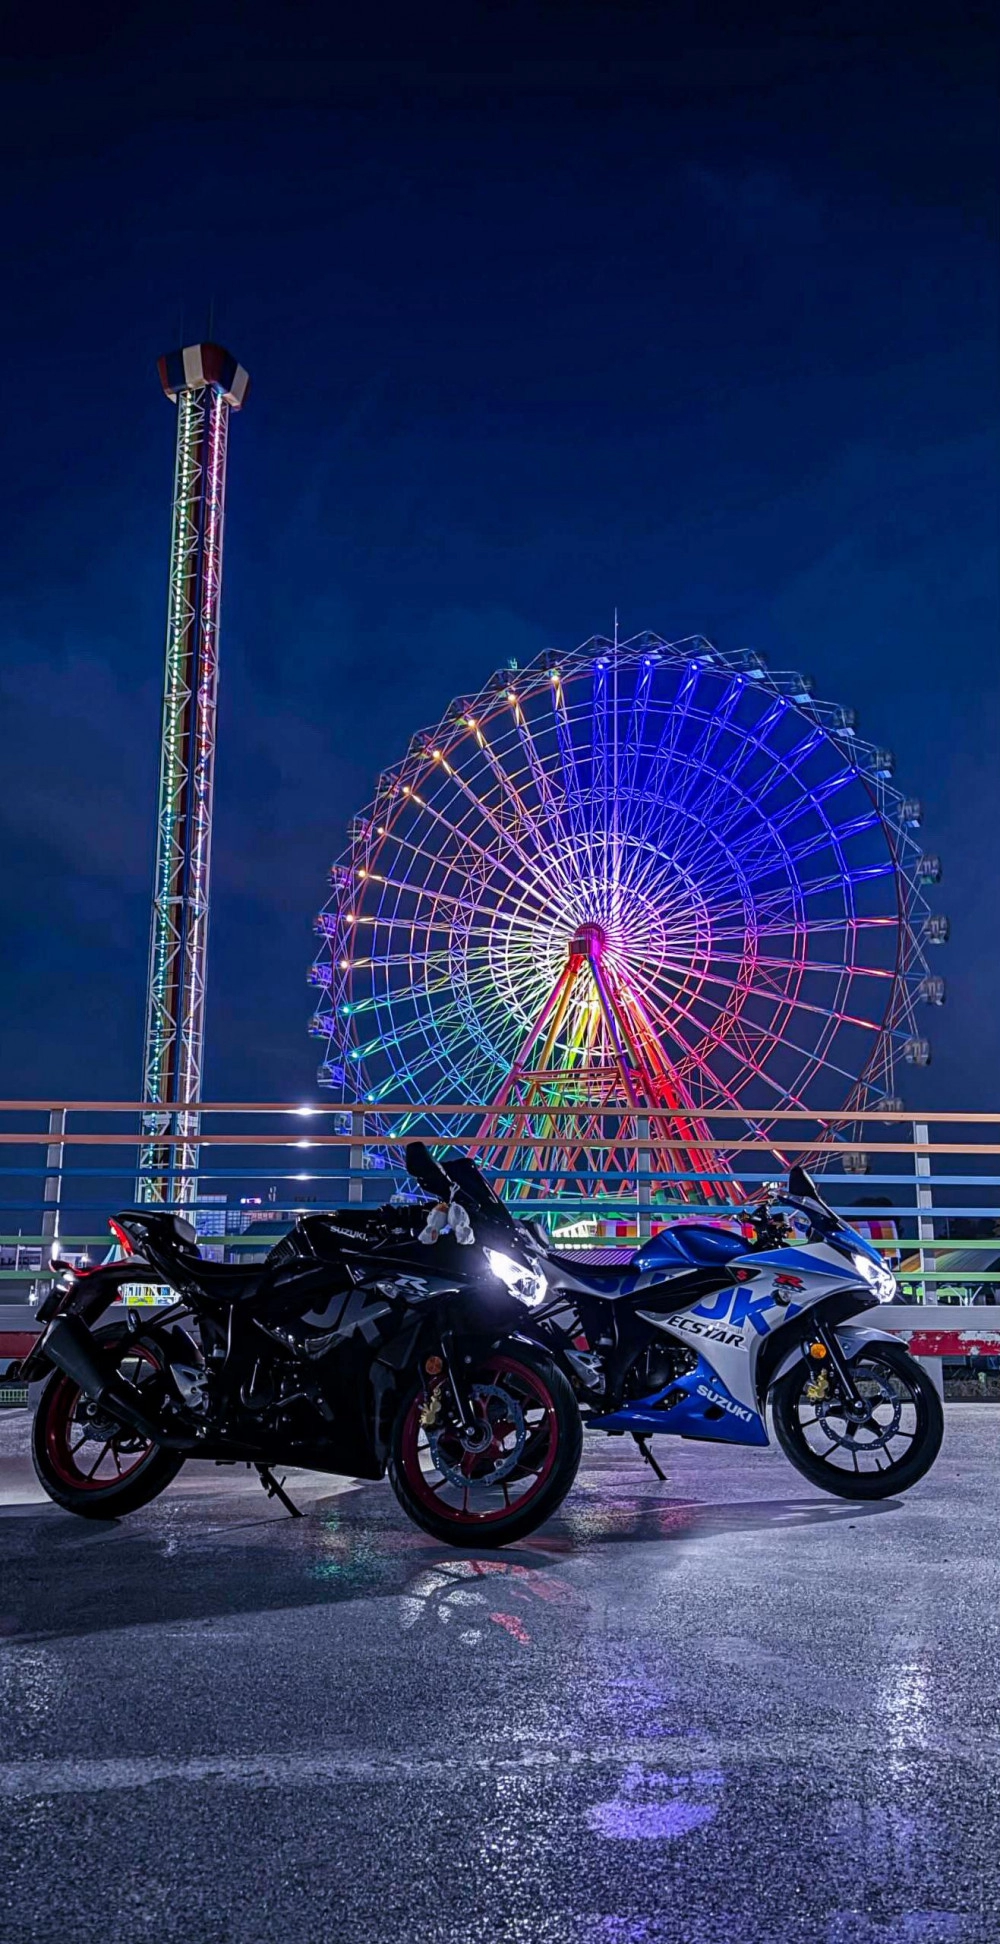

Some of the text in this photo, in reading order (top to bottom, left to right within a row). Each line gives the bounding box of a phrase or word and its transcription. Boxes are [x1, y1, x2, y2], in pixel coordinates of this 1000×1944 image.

[330, 1225, 367, 1240] SUZUKI
[667, 1315, 745, 1349] ECSTAR
[696, 1384, 753, 1423] SUZUKI
